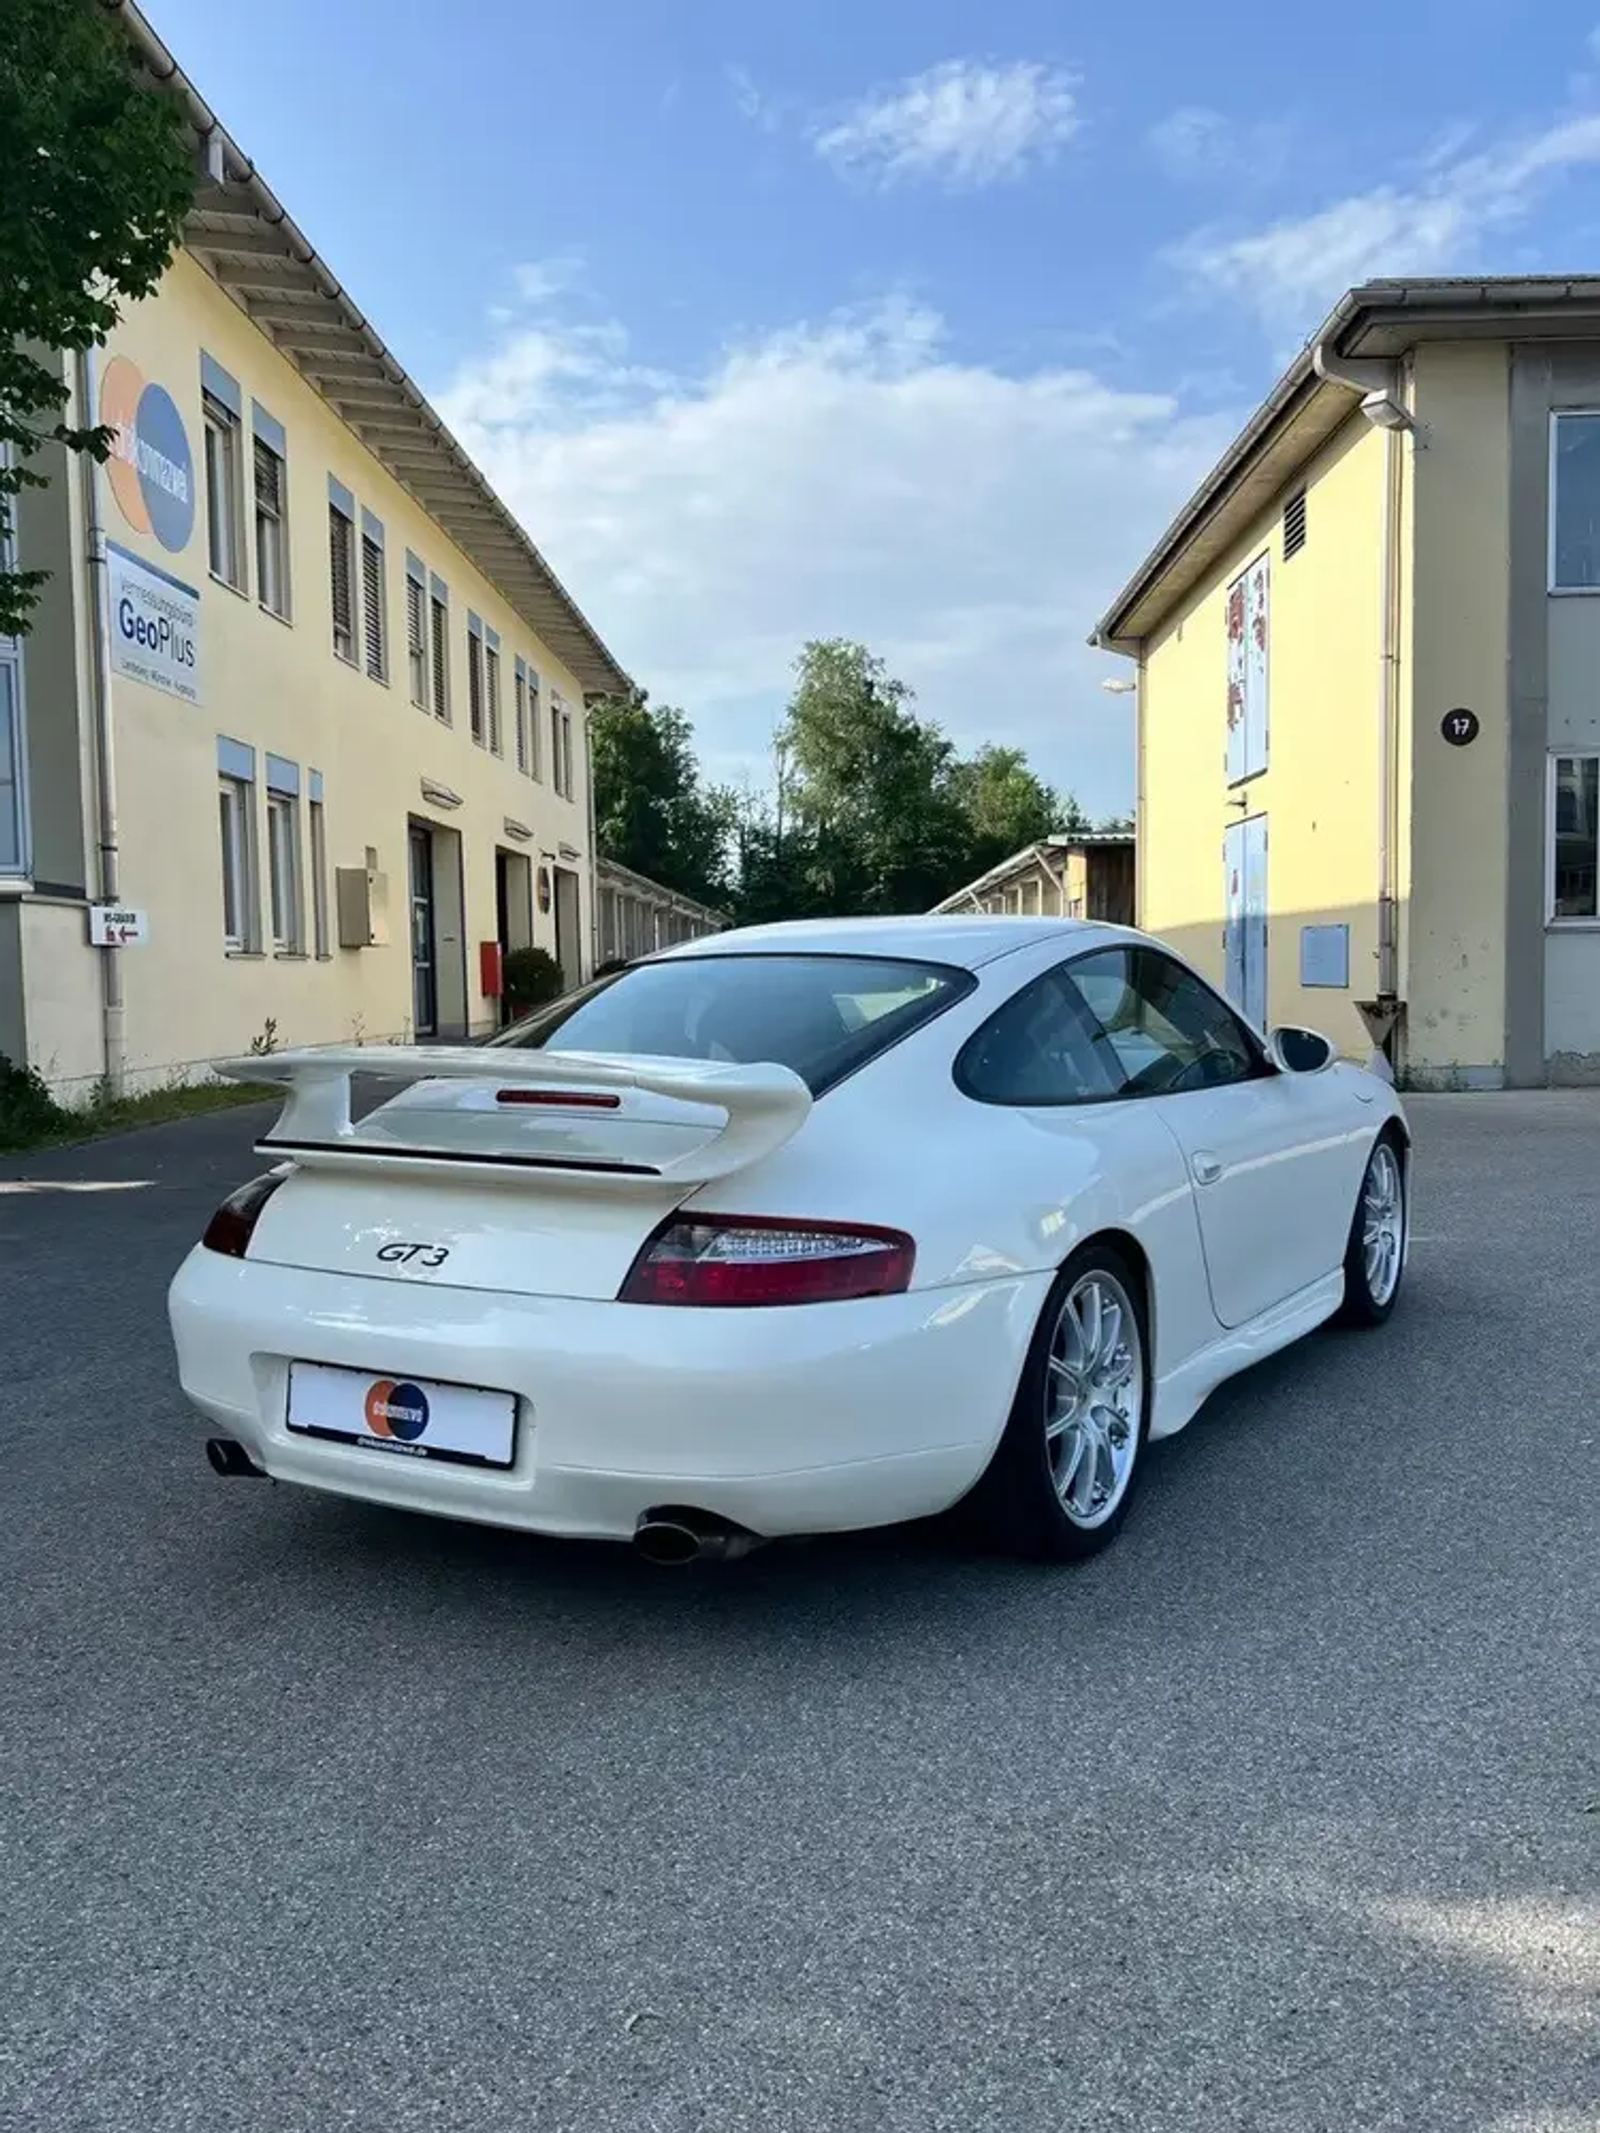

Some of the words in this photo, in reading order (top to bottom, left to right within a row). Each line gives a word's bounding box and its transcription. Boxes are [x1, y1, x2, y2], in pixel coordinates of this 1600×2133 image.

[119, 597, 195, 668] GeoPlus
[1452, 718, 1469, 735] 17
[377, 1243, 449, 1267] GT3
